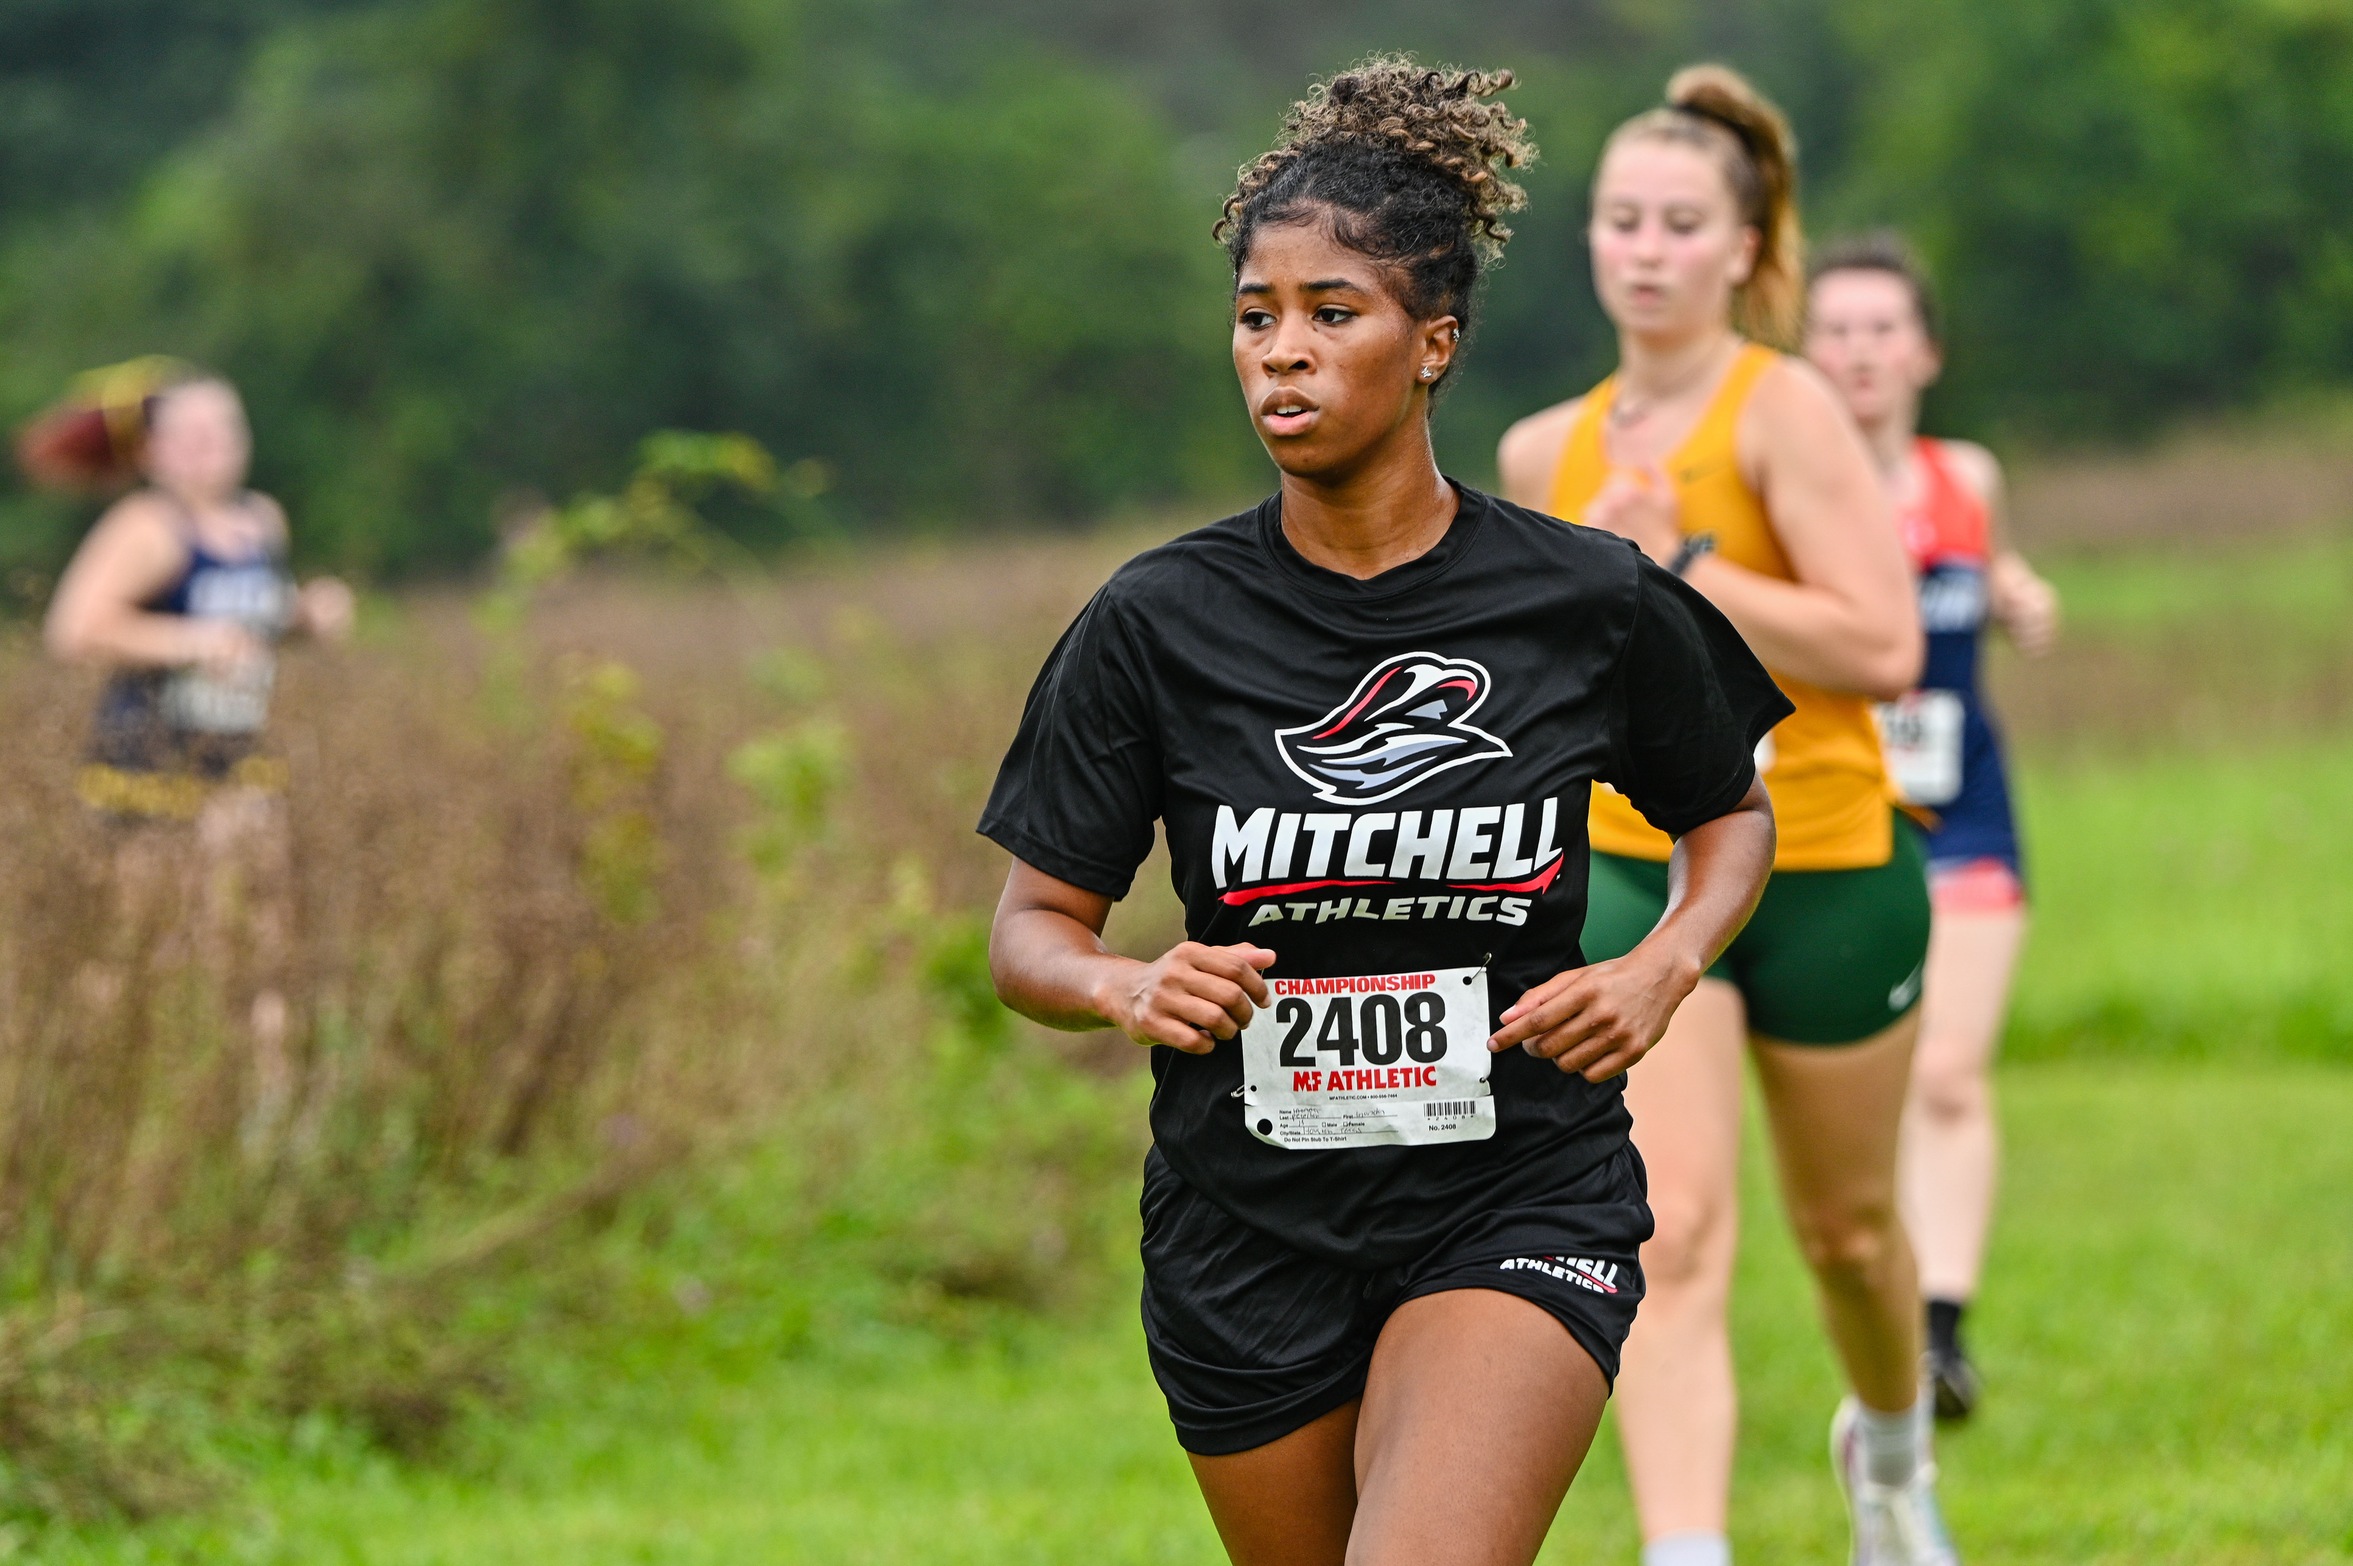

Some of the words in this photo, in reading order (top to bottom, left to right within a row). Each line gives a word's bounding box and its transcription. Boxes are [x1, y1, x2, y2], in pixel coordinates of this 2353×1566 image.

[1211, 797, 1563, 889] MITCHELL
[1248, 896, 1532, 927] ATHLETICS
[1274, 974, 1436, 995] CHAMPIONSHIP
[1275, 991, 1448, 1067] 2408
[1293, 1071, 1322, 1092] MF
[1327, 1066, 1437, 1091] ATHLETIC
